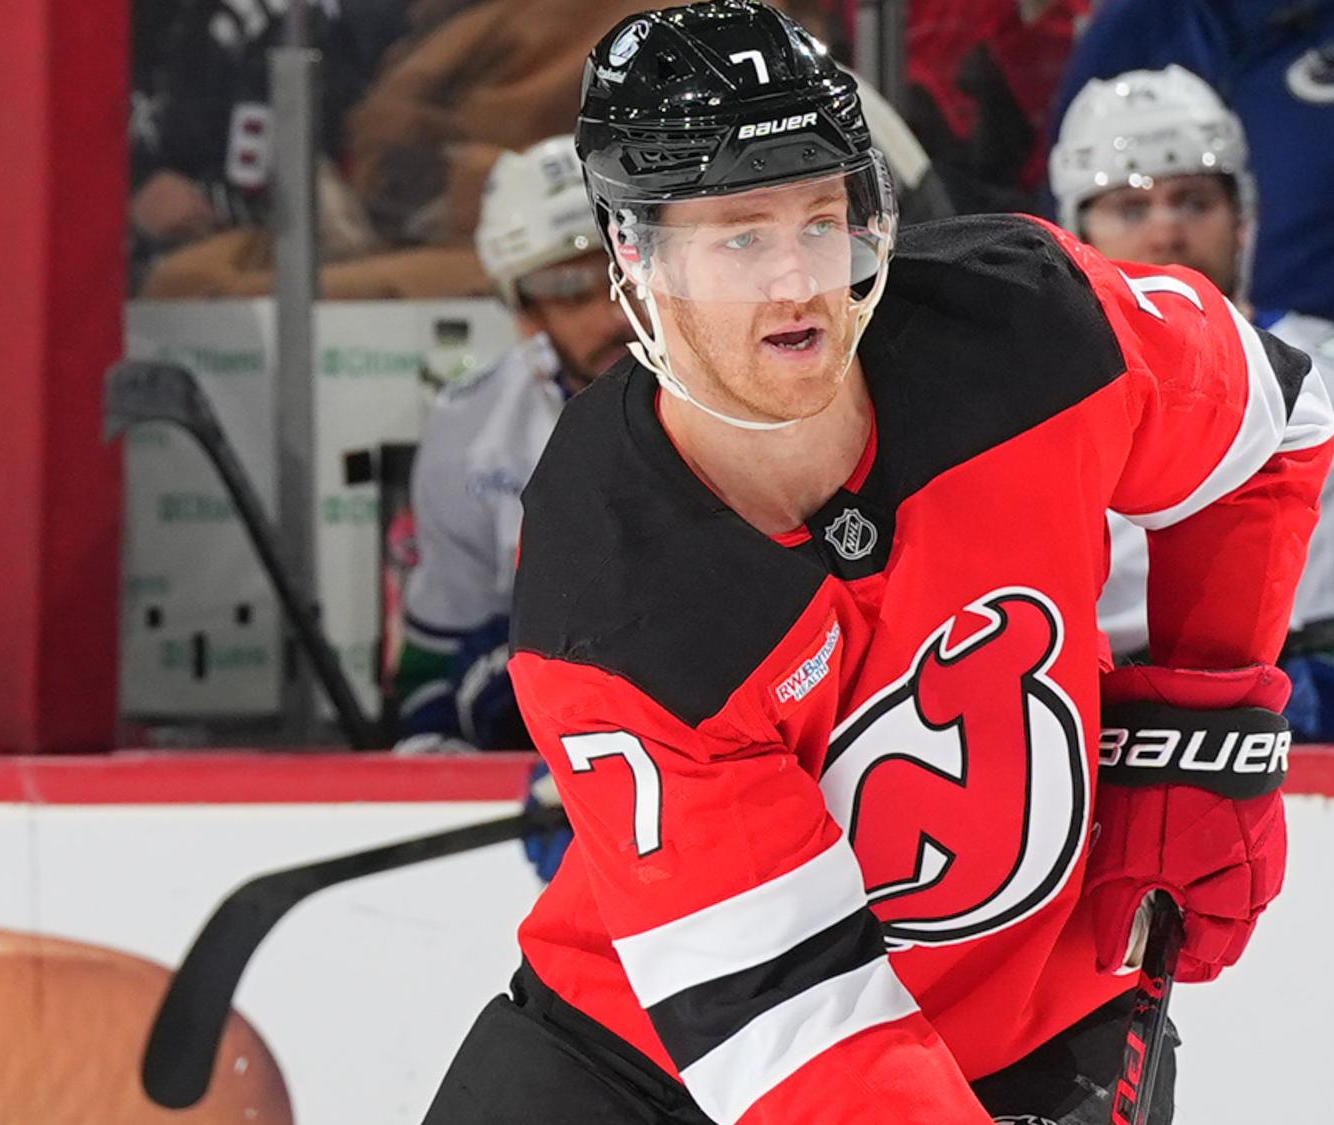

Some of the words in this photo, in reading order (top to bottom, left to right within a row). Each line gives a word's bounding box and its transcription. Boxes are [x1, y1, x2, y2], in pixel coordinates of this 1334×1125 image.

[729, 50, 769, 85] 7
[738, 112, 817, 140] BAUER
[1099, 728, 1292, 774] BAUER
[560, 730, 663, 858] 7
